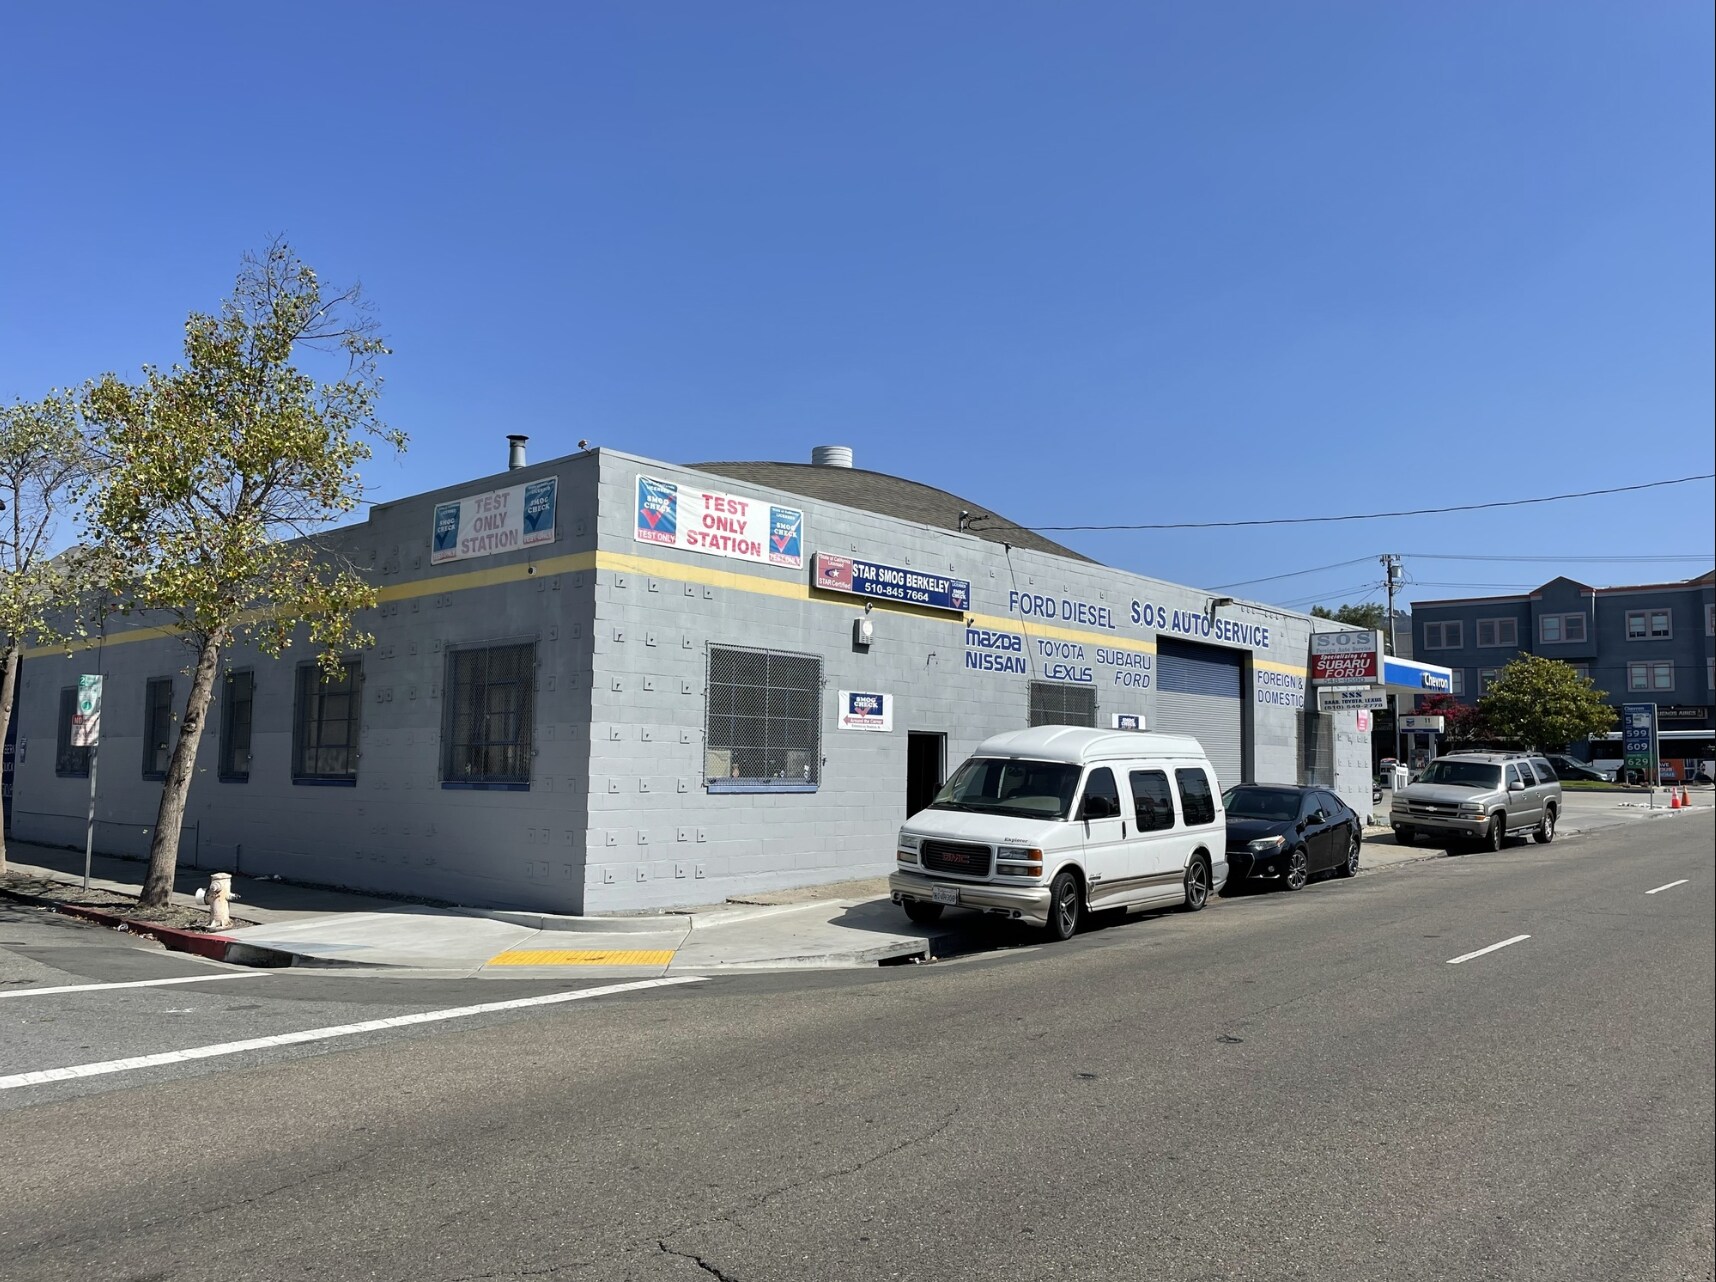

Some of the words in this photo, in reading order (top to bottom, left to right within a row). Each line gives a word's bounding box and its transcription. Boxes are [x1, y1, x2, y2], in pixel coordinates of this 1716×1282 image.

[474, 492, 511, 514] TEST
[702, 494, 749, 517] TEST
[473, 512, 508, 534] ONLY
[702, 513, 748, 535] ONLY
[461, 529, 519, 555] STATION
[638, 529, 656, 539] TEST
[657, 532, 676, 543] ONLY
[686, 529, 761, 557] STATION
[852, 563, 877, 581] STAR
[878, 568, 905, 586] SMOG
[906, 573, 950, 594] BERKELEY
[864, 582, 904, 598] 510-845
[906, 589, 929, 602] 7664
[1009, 590, 1056, 619] FORD
[1062, 600, 1116, 630] DIESEL
[1171, 610, 1211, 637] AUTO
[1215, 618, 1269, 649] SERVICE
[1037, 640, 1085, 661] TOYOTA
[1096, 648, 1151, 670] SUBARU
[965, 651, 1026, 675] NISSAN
[1044, 662, 1093, 682] LEXUS
[1316, 659, 1371, 670] SUBARU
[1325, 668, 1365, 678] FORD
[1114, 671, 1150, 689] FORD
[1257, 670, 1296, 690] FOREIGN
[1298, 677, 1304, 690] &
[1422, 671, 1449, 689] Chevron
[1257, 689, 1304, 708] DOMESTIC
[1626, 729, 1647, 738] 599
[1627, 743, 1648, 751] 609
[1628, 758, 1649, 766] 629
[942, 853, 970, 864] GMC
